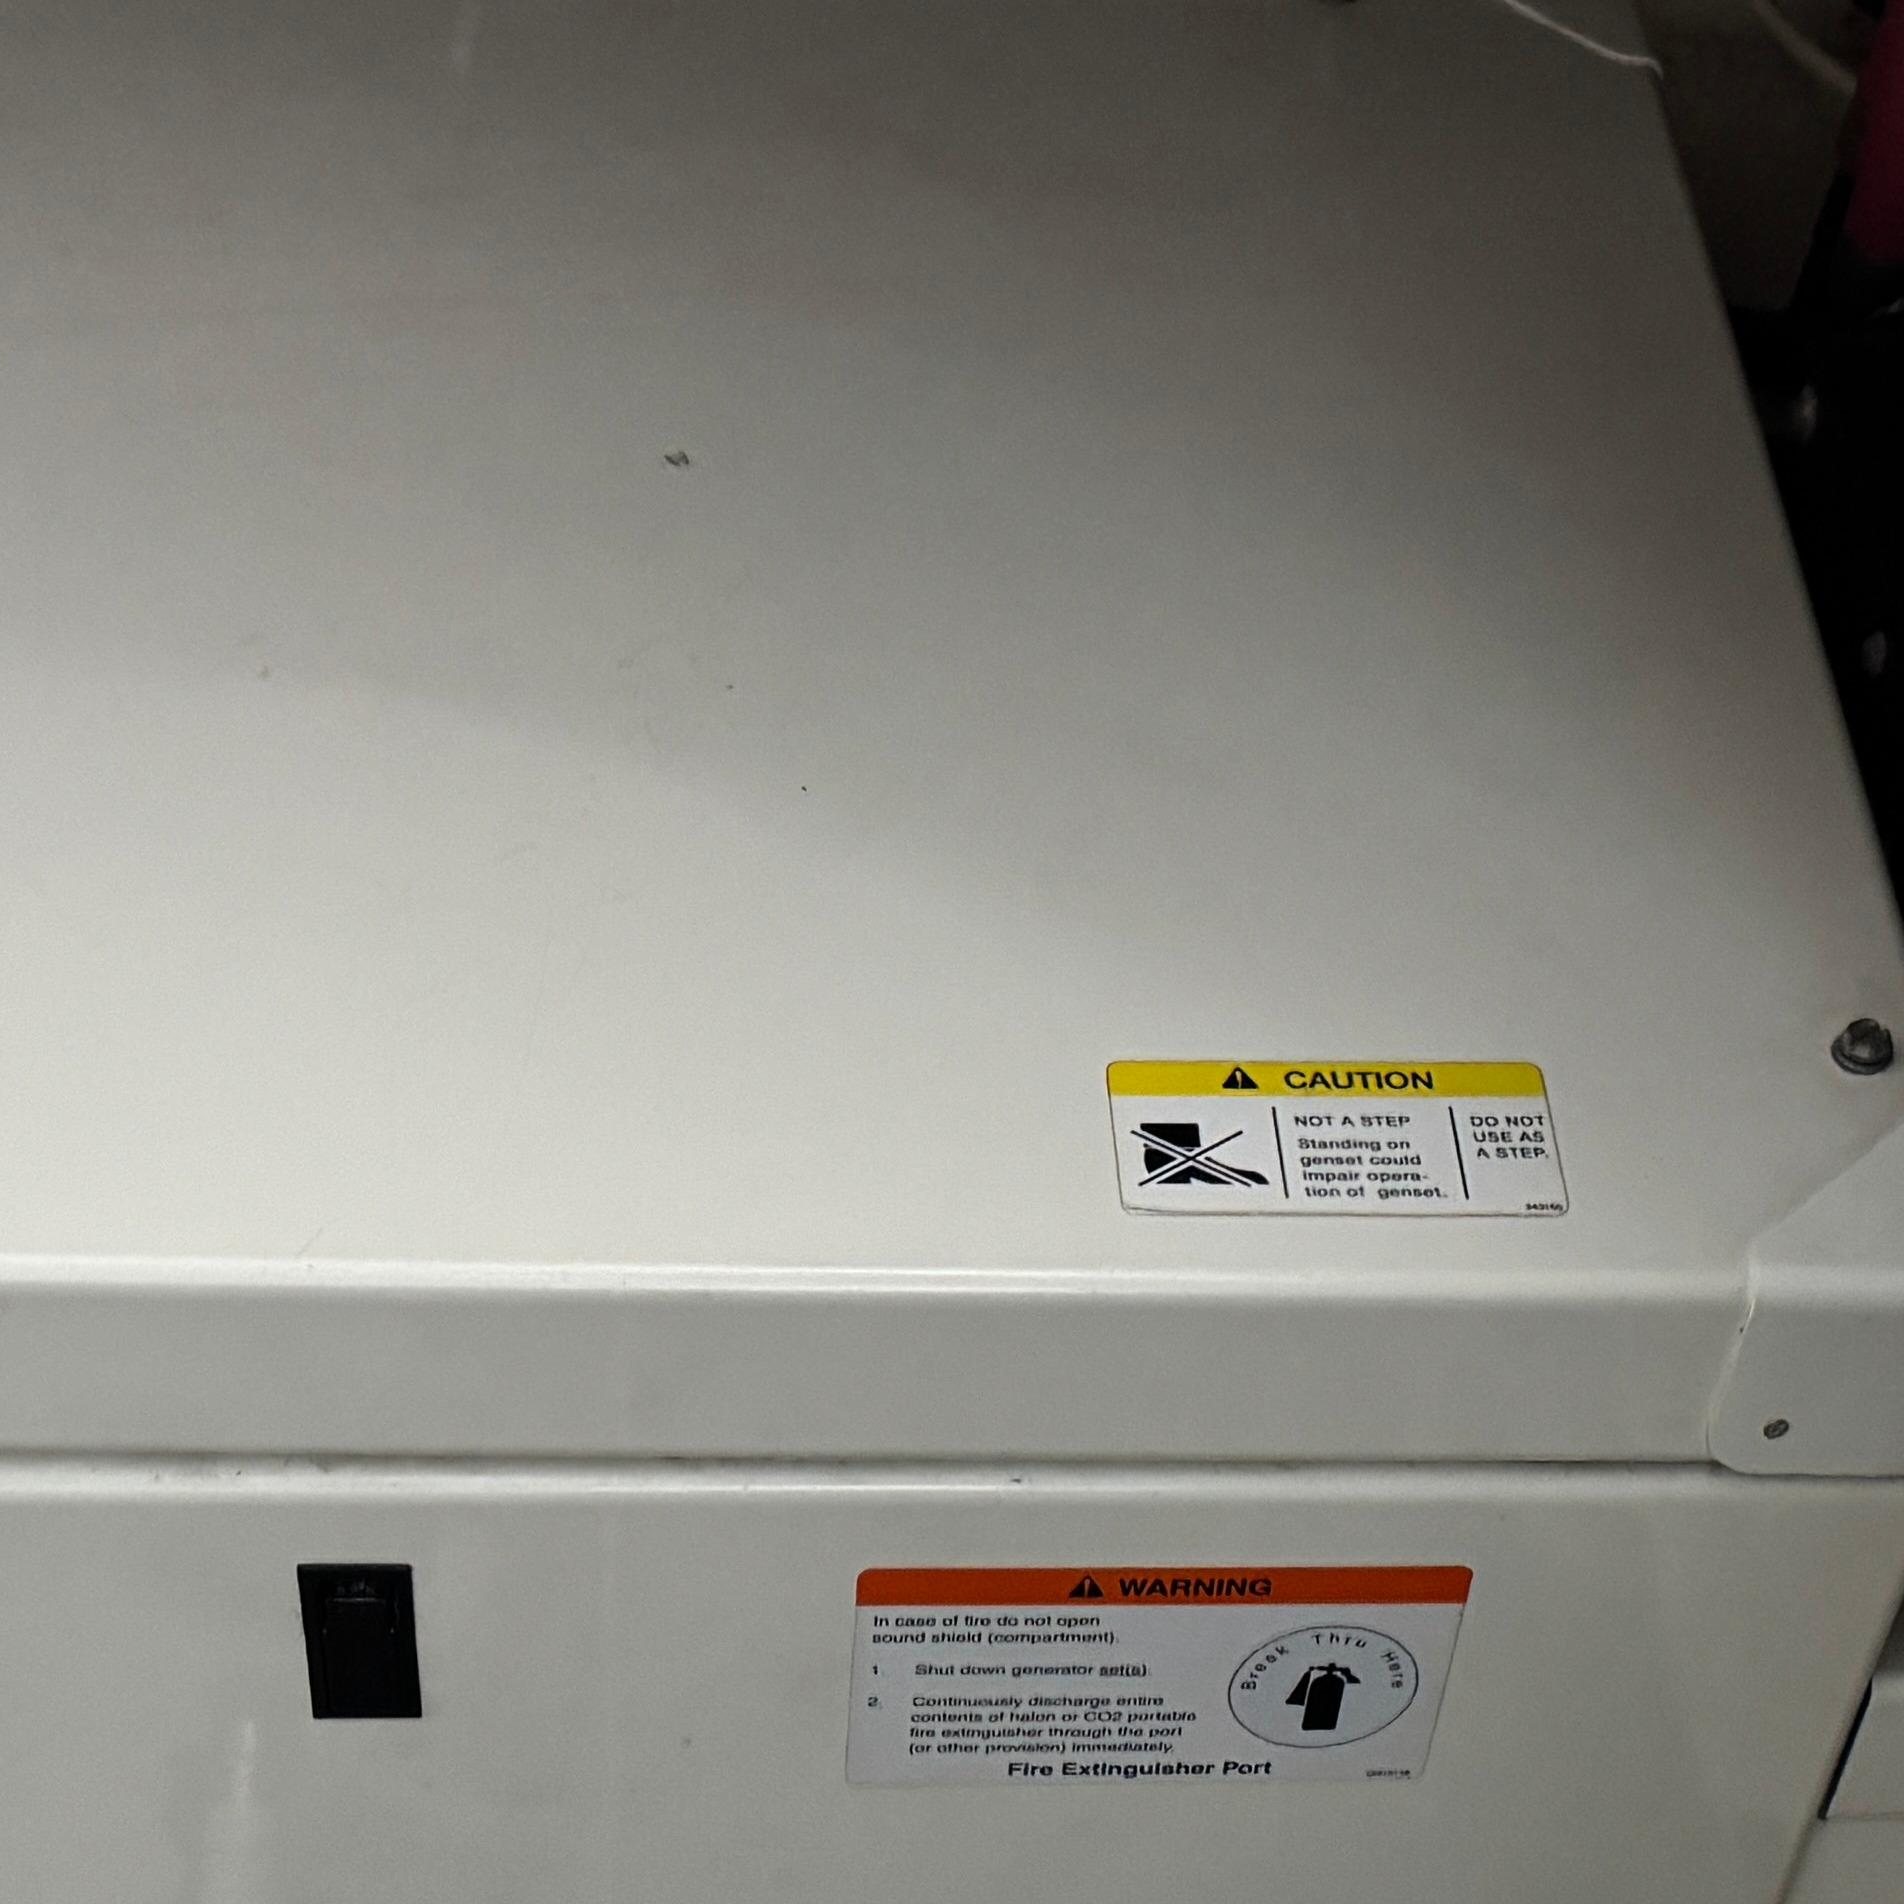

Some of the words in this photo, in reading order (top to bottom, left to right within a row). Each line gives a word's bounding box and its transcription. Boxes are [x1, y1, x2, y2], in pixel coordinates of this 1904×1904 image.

[1282, 1070, 1434, 1091] CAUTION
[1294, 1115, 1334, 1127] NOT
[1341, 1116, 1355, 1127] A
[1360, 1115, 1411, 1127] STEP
[1470, 1115, 1499, 1127] DO
[1504, 1115, 1543, 1127] NOT
[1473, 1130, 1513, 1143] USE
[1519, 1131, 1545, 1143] AS
[1298, 1137, 1382, 1152] Standing
[1386, 1139, 1411, 1150] on
[1477, 1147, 1491, 1159] A
[1300, 1155, 1364, 1168] genset
[1369, 1154, 1422, 1166] could
[1303, 1170, 1360, 1184] impair
[1305, 1186, 1341, 1198] tion
[1346, 1186, 1365, 1198] of
[1119, 1577, 1274, 1598] WARNING
[873, 1615, 889, 1627] In
[942, 1615, 959, 1627] of
[964, 1615, 992, 1627] fire
[1024, 1615, 1052, 1627] not
[872, 1632, 926, 1644] sound
[931, 1632, 983, 1644] shield
[1311, 1633, 1369, 1649] Thru
[915, 1664, 954, 1676] Shut
[960, 1664, 1006, 1676] down
[1008, 1762, 1053, 1776] Fire
[1061, 1761, 1215, 1779] Extinguisher
[1222, 1761, 1272, 1776] Port
